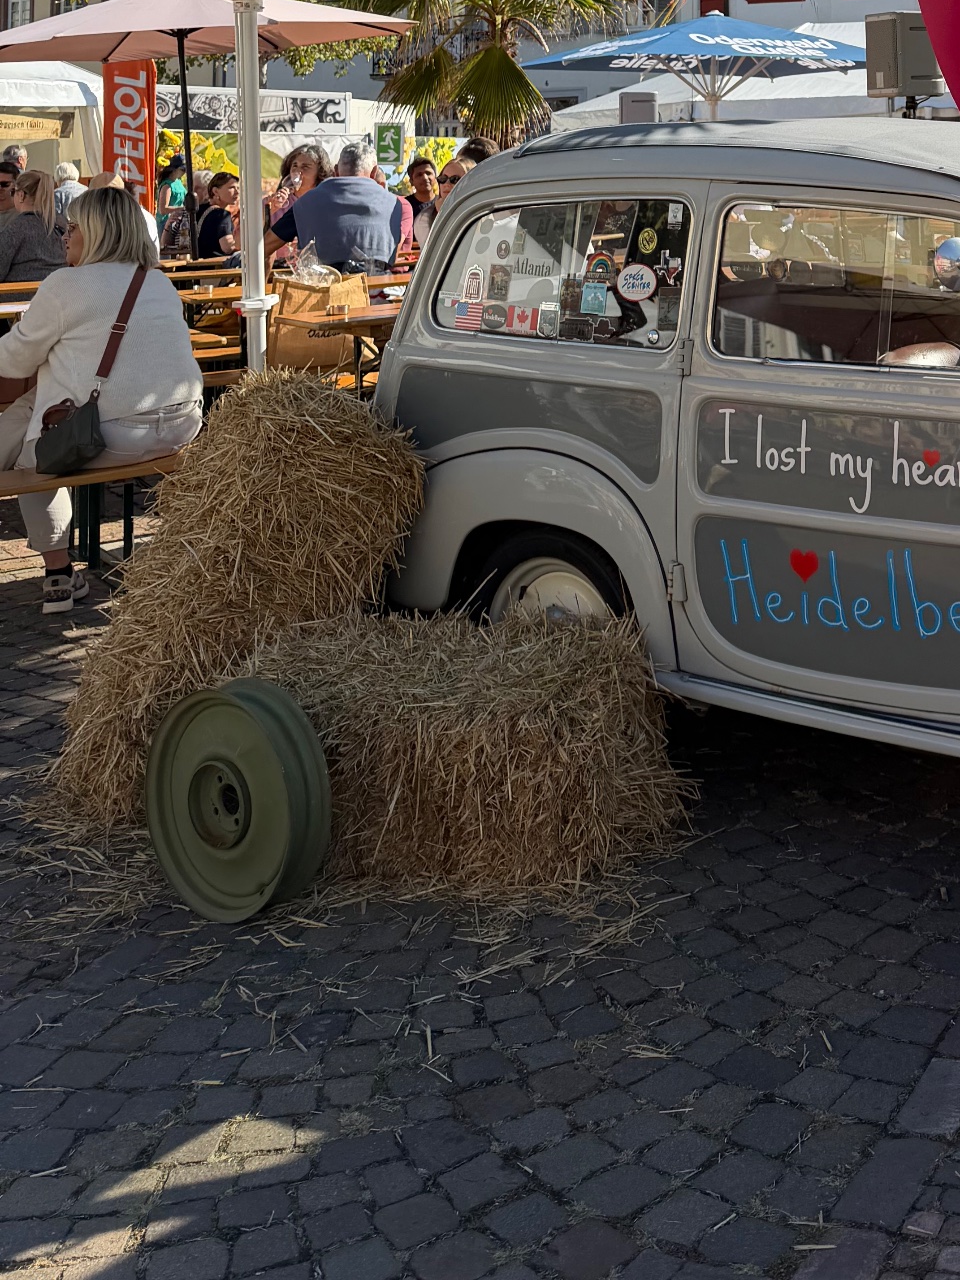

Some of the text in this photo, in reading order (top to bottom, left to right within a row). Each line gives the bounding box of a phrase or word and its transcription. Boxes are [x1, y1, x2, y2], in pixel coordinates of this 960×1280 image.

[688, 33, 838, 50] Odenwald
[731, 44, 828, 57] Quelle
[513, 257, 551, 277] Atlanta
[718, 408, 738, 464] I
[755, 414, 811, 474] lost
[830, 452, 873, 513] my
